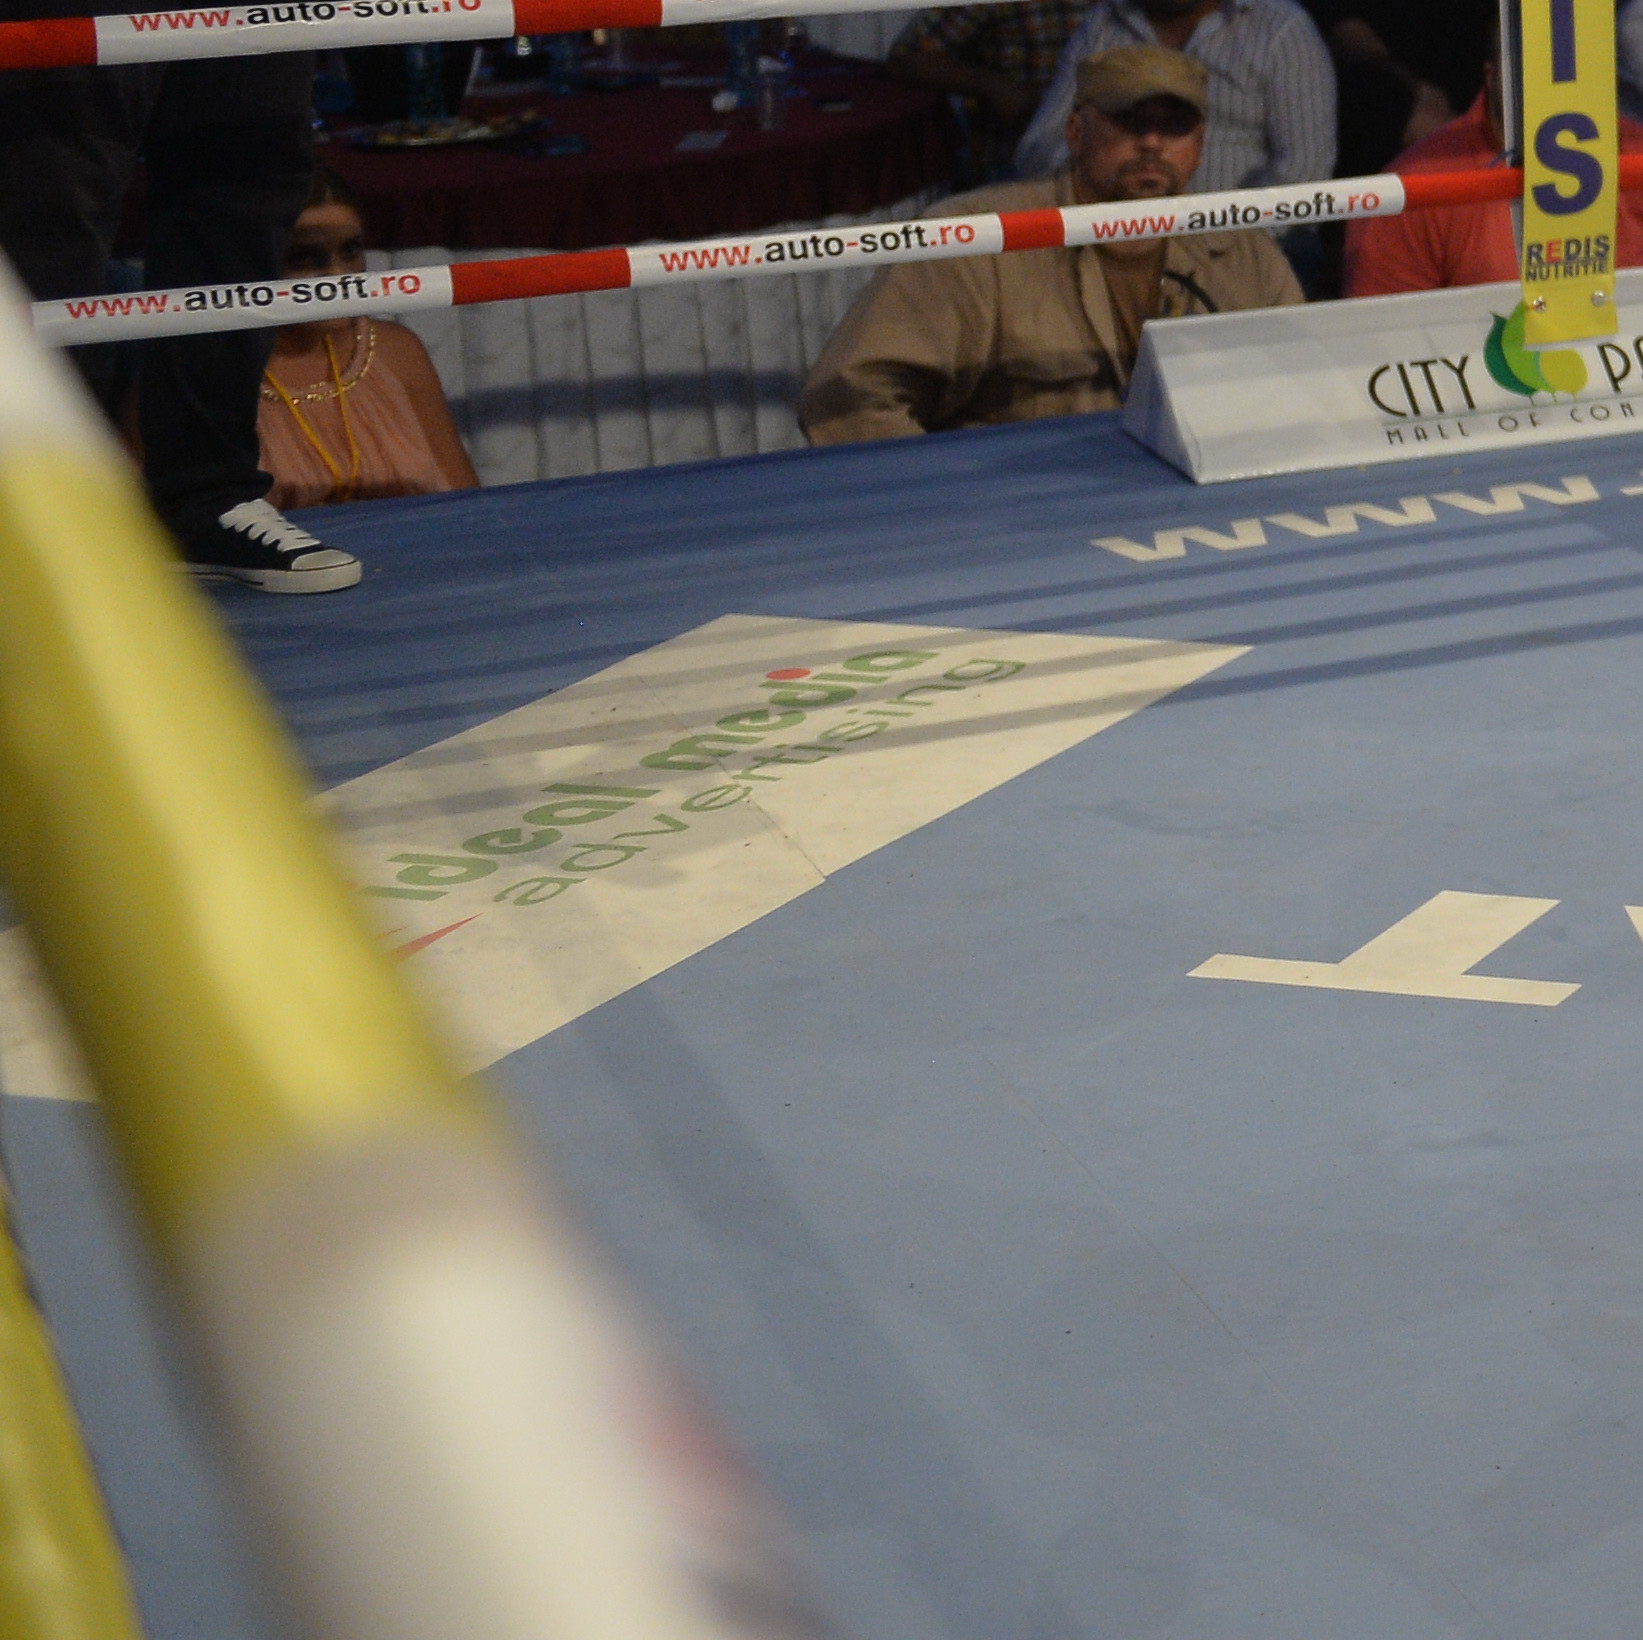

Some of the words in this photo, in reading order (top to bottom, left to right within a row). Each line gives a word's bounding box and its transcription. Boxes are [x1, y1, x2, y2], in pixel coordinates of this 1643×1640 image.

[65, 271, 421, 320] www.auto-soft.ro
[659, 221, 976, 273] www.auto-soft.ro
[1092, 189, 1381, 240] www.auto-soft.ro
[1525, 234, 1611, 264] REDIS
[1367, 354, 1477, 419] CITY
[1386, 420, 1470, 446] MALL
[492, 658, 1027, 906] advertising
